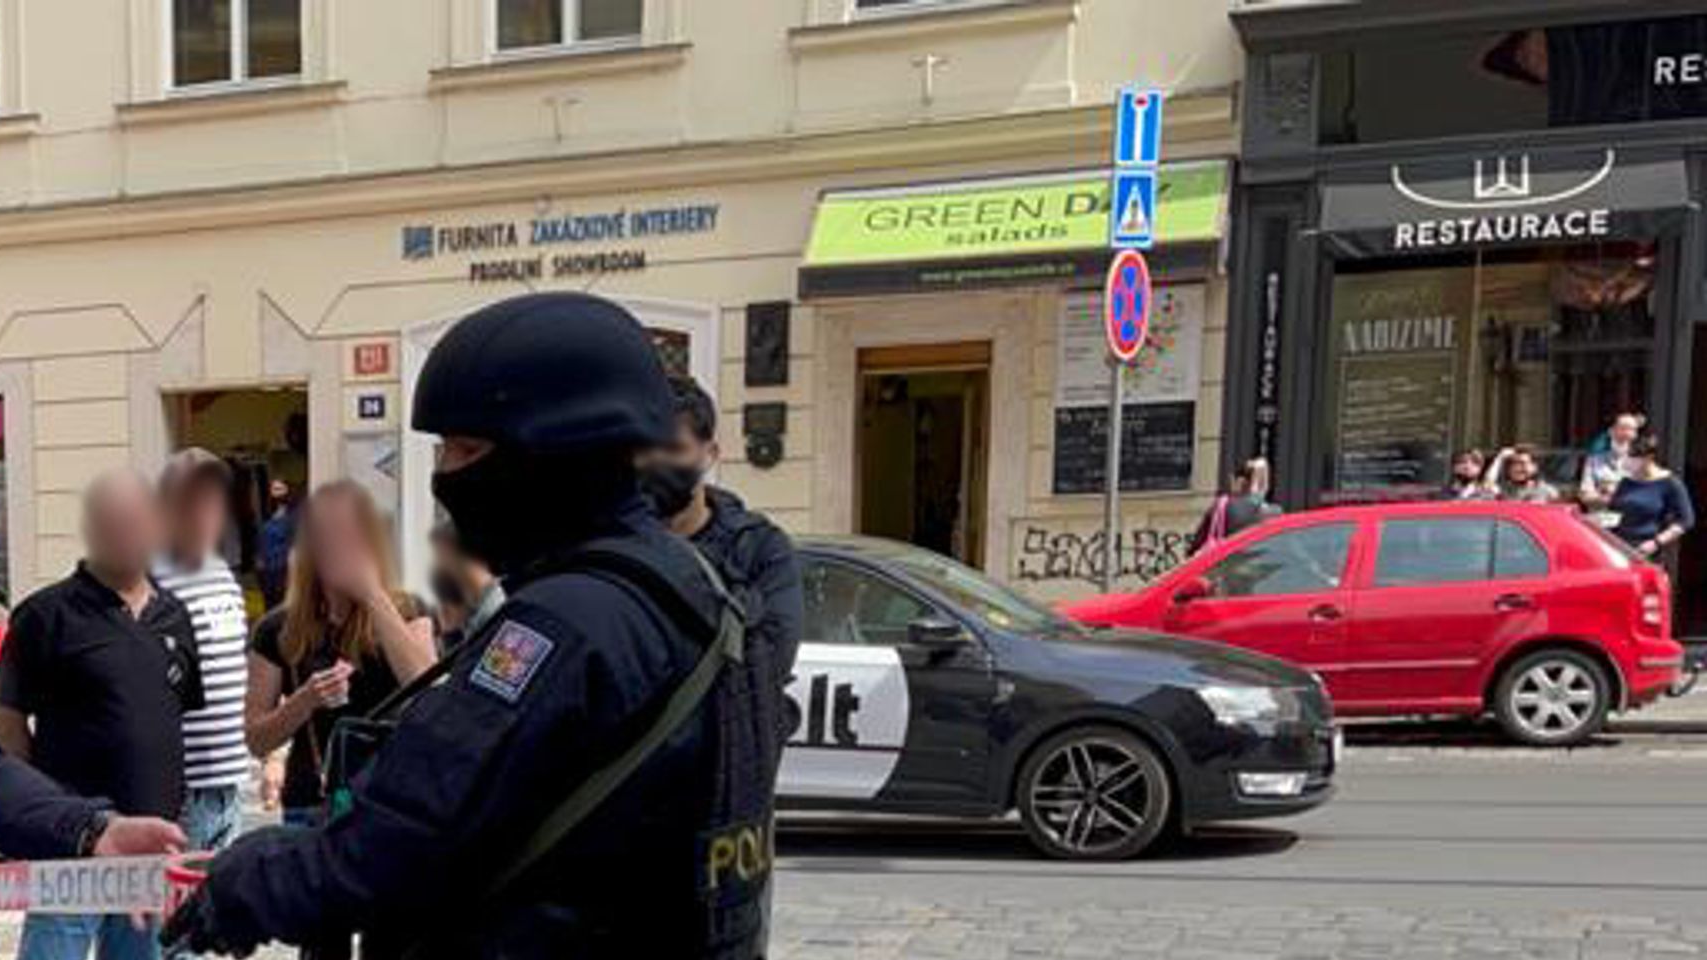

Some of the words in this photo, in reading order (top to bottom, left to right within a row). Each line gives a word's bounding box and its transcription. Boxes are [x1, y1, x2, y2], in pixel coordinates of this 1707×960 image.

[1654, 53, 1707, 85] RE
[864, 195, 1046, 232] GREEN
[1395, 208, 1611, 250] RESTAURACE
[437, 219, 519, 255] FURNITA
[946, 223, 1069, 246] salads
